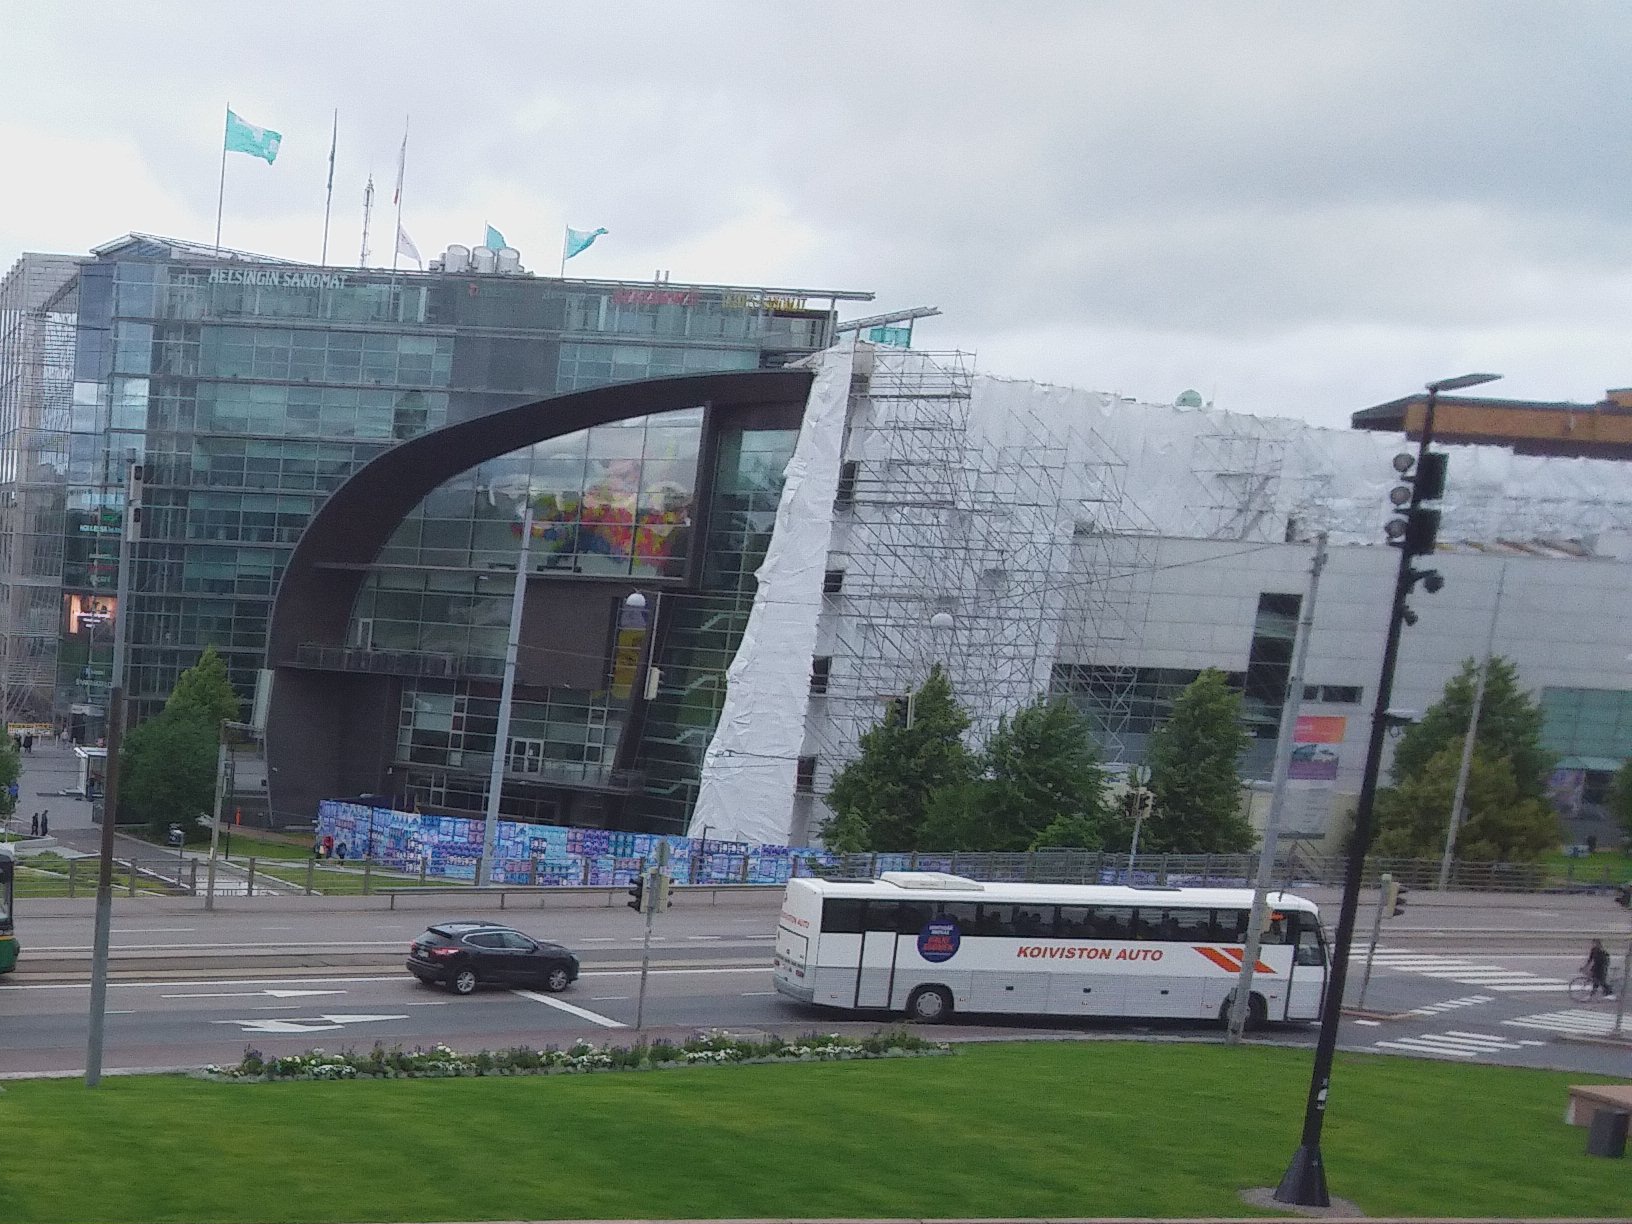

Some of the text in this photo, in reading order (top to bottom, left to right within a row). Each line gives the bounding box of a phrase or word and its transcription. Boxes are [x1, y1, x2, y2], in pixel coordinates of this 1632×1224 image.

[208, 268, 347, 289] HELSINGIN SANOMAT
[1016, 946, 1164, 961] KOIVISTON AUTO
